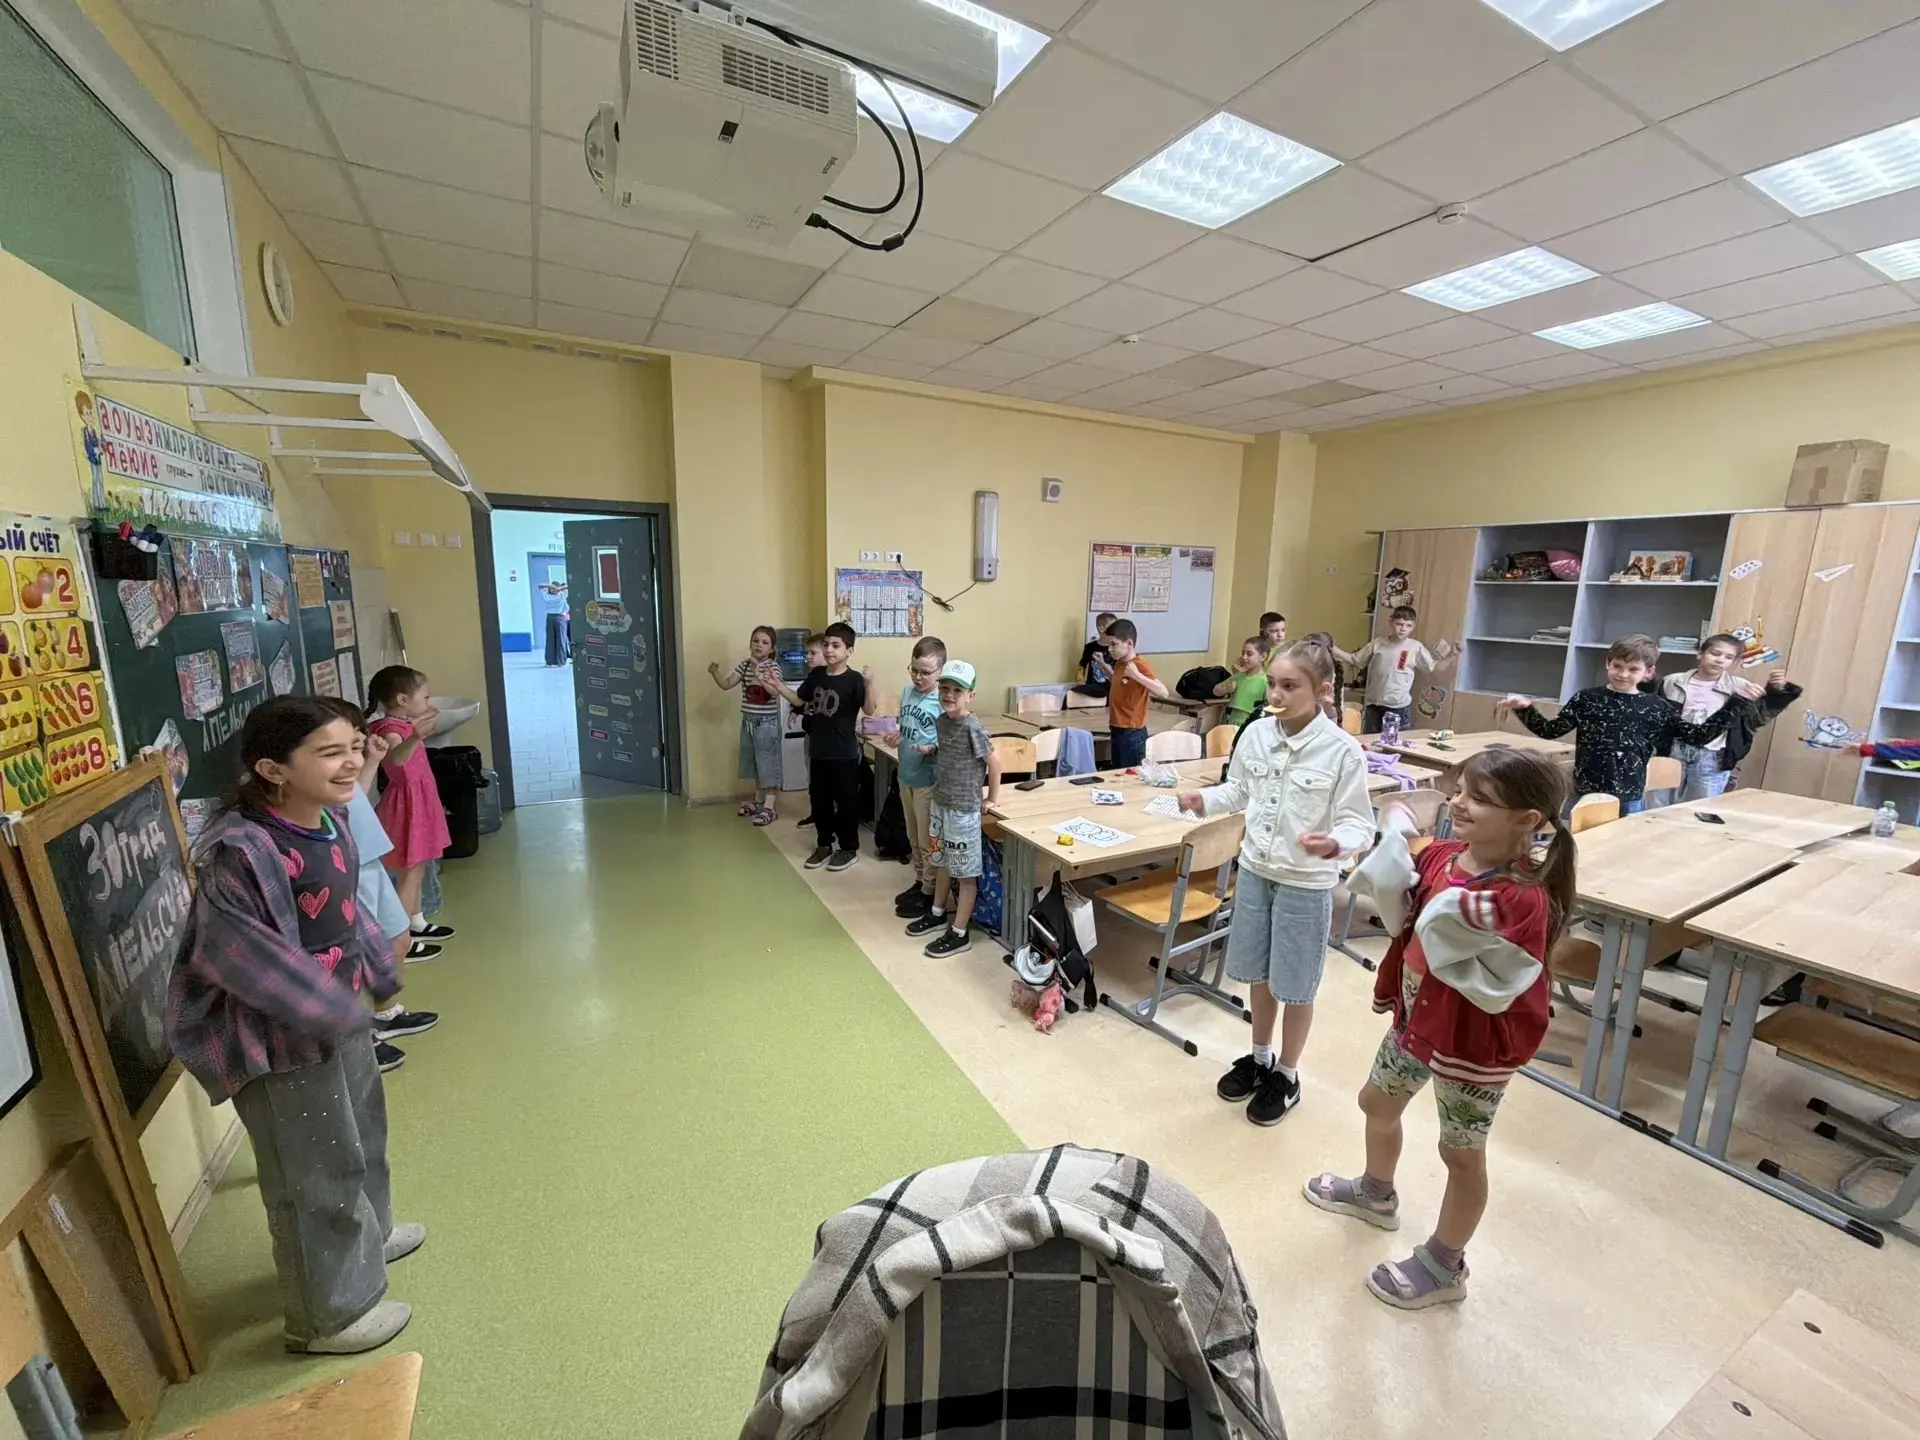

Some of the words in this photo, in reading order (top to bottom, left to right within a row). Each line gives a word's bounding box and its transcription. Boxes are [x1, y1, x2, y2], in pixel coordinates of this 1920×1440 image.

[30, 527, 61, 554] СЧЁТ
[56, 567, 74, 603] 2
[67, 625, 84, 659] 4
[77, 681, 95, 716] 6
[910, 705, 934, 729] COAST
[87, 736, 105, 771] 8
